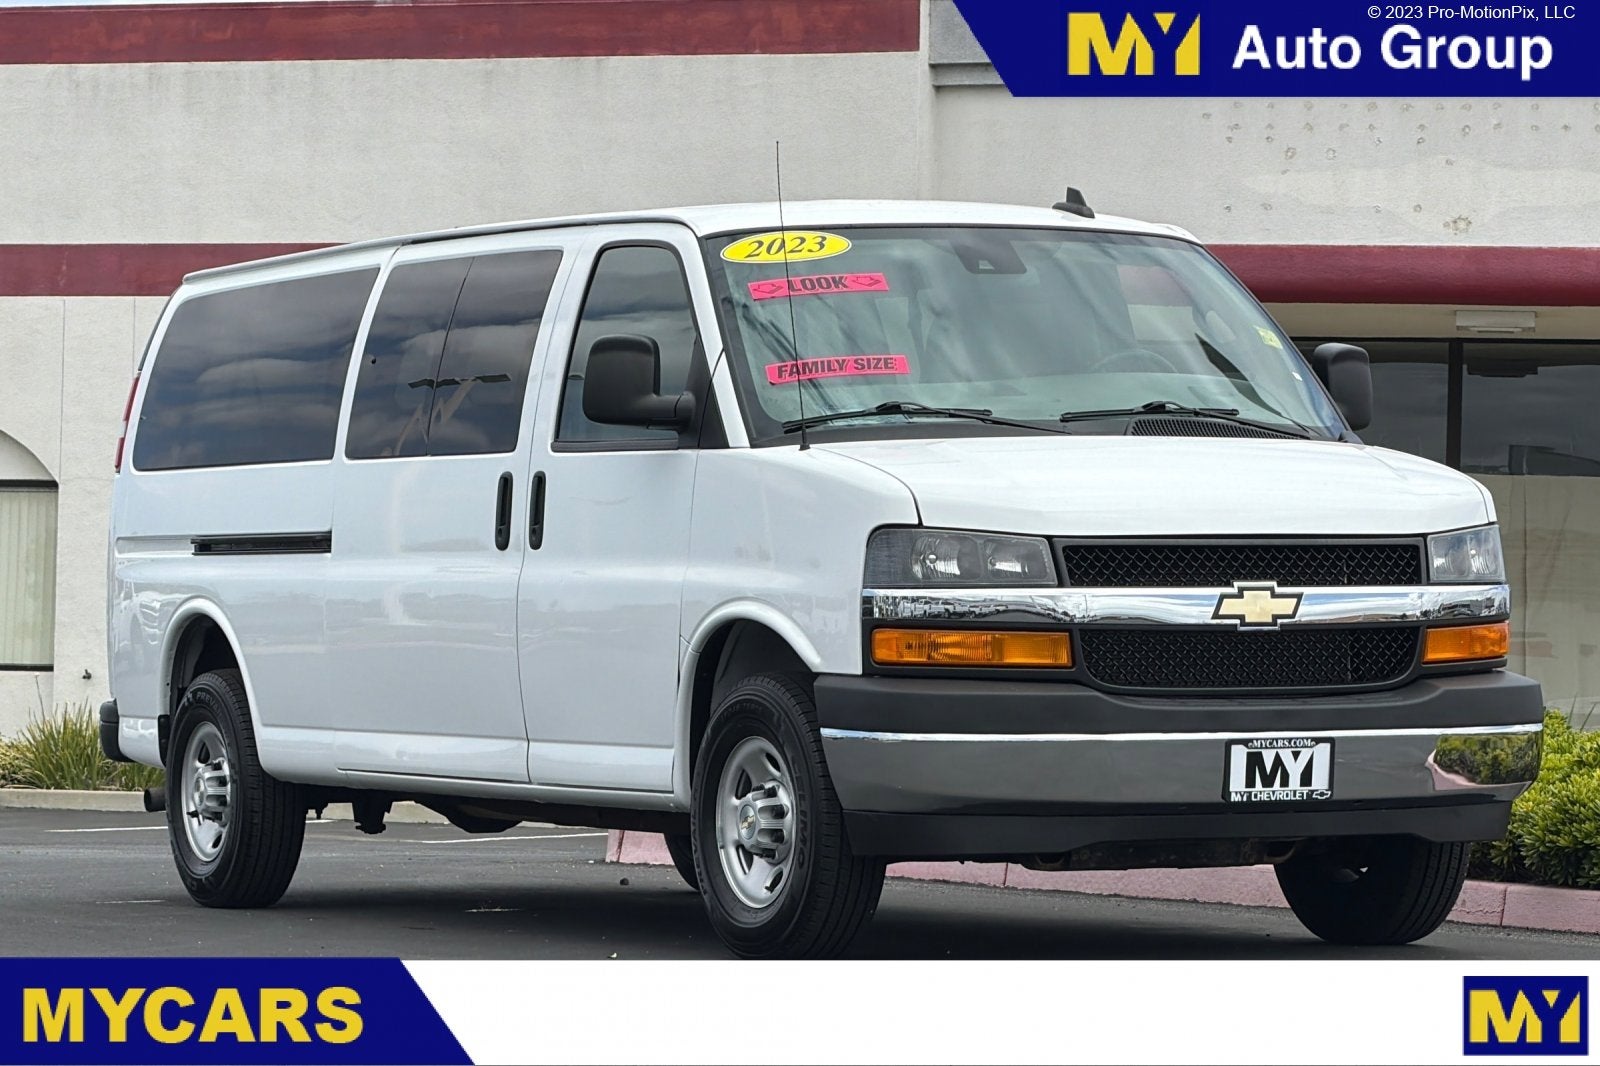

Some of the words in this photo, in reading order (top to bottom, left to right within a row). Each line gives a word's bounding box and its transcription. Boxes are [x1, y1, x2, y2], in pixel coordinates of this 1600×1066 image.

[745, 235, 827, 258] 2023
[789, 275, 848, 292] LOOK
[777, 357, 849, 379] FAMILY
[853, 356, 895, 371] SIZE
[1245, 751, 1314, 788] MY
[1231, 791, 1247, 802] MY
[1251, 790, 1309, 801] CHEVROLET
